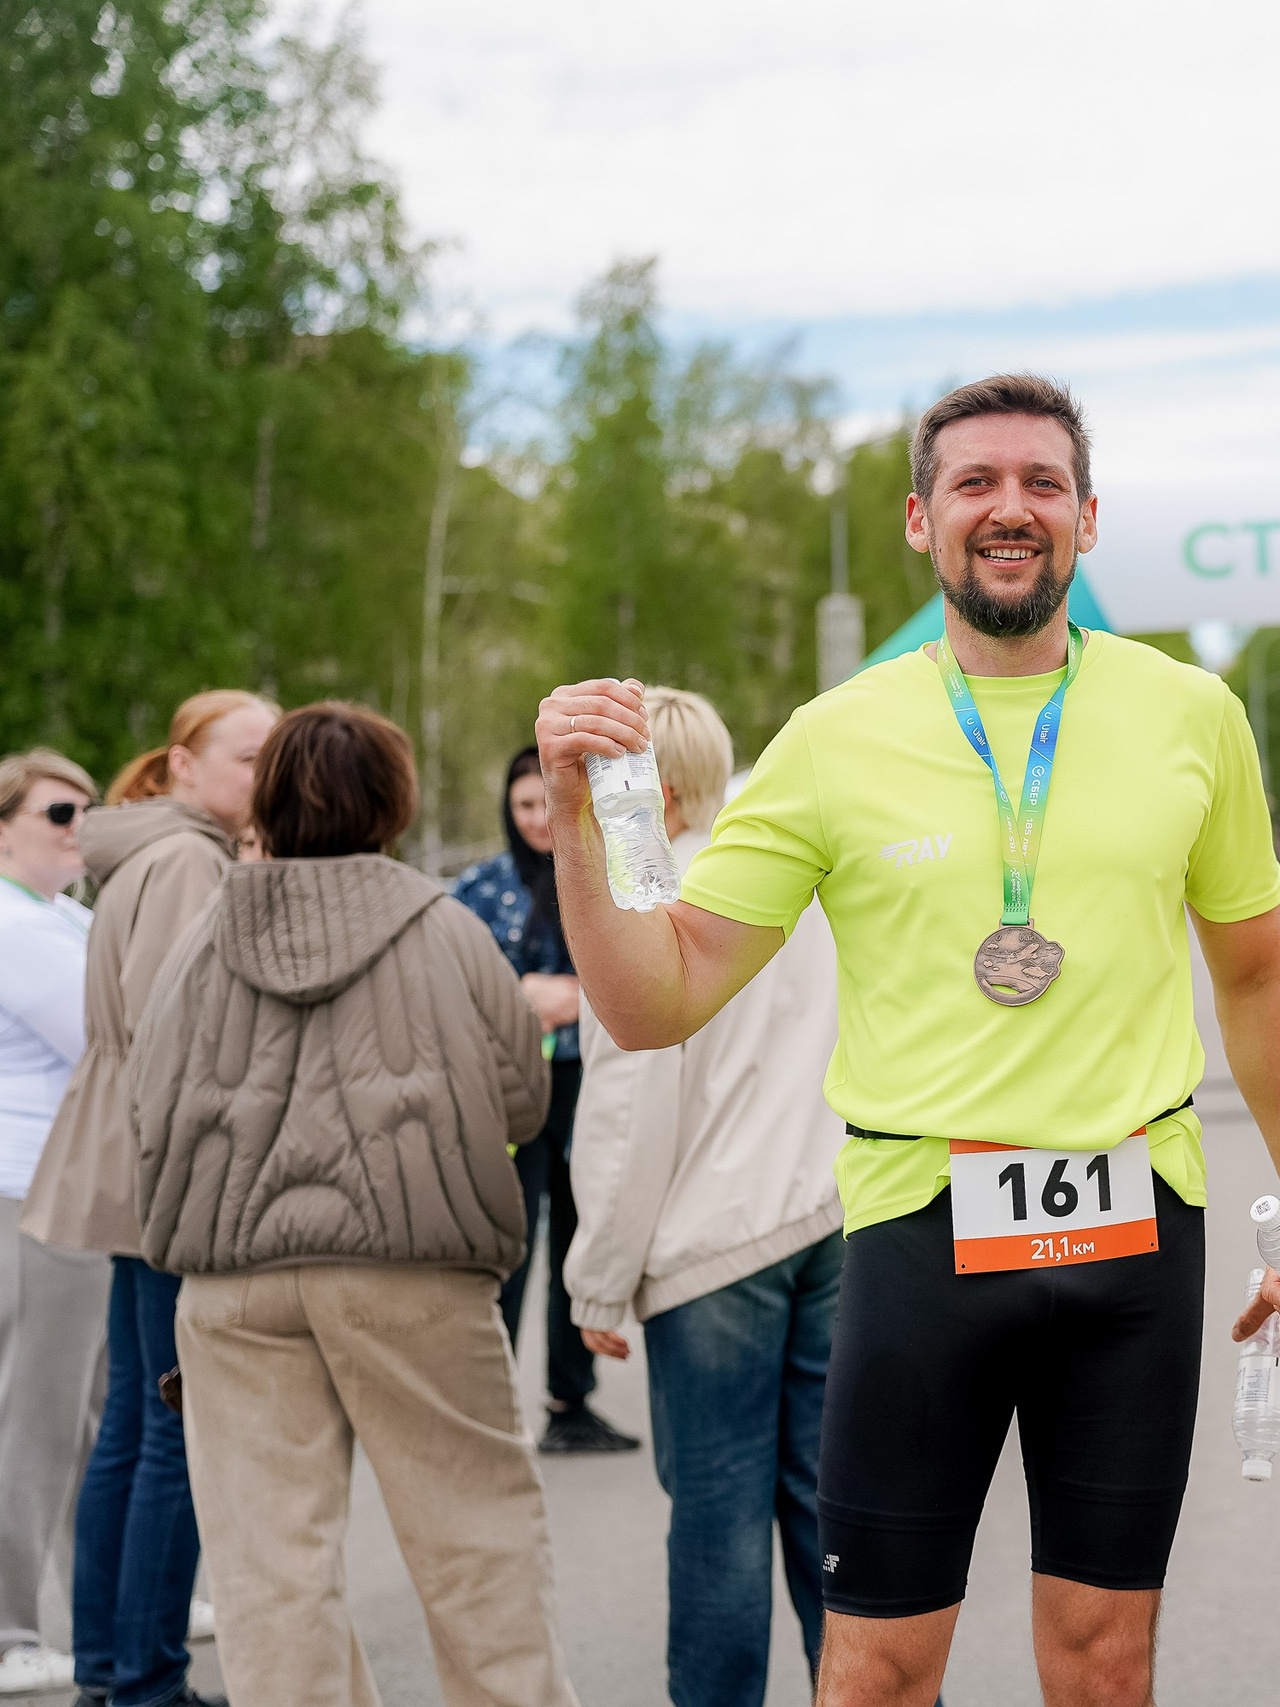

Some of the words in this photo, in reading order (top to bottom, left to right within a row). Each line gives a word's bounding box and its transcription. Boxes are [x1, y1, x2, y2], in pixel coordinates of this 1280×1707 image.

[1039, 723, 1051, 744] Utair
[1029, 779, 1041, 806] СБЕР
[1024, 818, 1034, 836] 185
[998, 1153, 1112, 1222] 161
